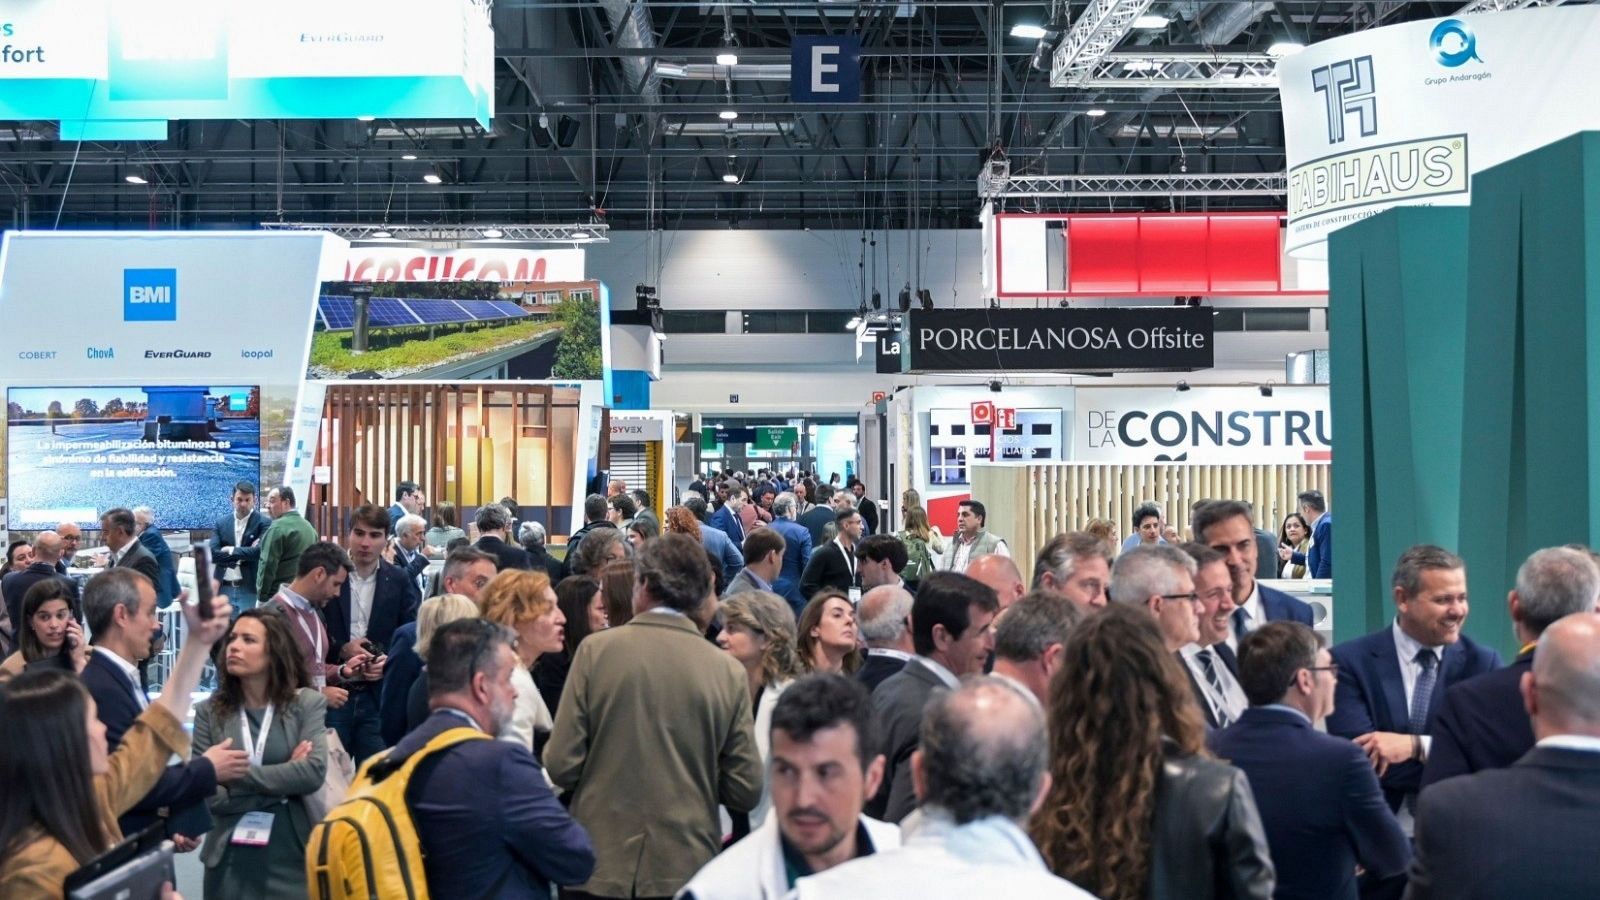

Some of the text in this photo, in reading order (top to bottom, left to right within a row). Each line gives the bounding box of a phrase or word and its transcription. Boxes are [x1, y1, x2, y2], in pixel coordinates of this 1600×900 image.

[2, 45, 45, 63] fort
[812, 46, 840, 92] E
[1424, 71, 1492, 86] Grupo Andaragón
[130, 286, 171, 304] BMI
[882, 337, 901, 355] La
[919, 326, 1205, 351] PORCELANOSA Offsite
[19, 351, 57, 360] COBERT
[87, 347, 115, 359] ChovA
[1089, 410, 1116, 429] DE
[609, 425, 643, 434] SYVEX
[157, 439, 217, 450] bituminosa
[218, 441, 231, 449] es
[1089, 430, 1116, 448] LA
[93, 454, 107, 463] de
[158, 455, 167, 466] y
